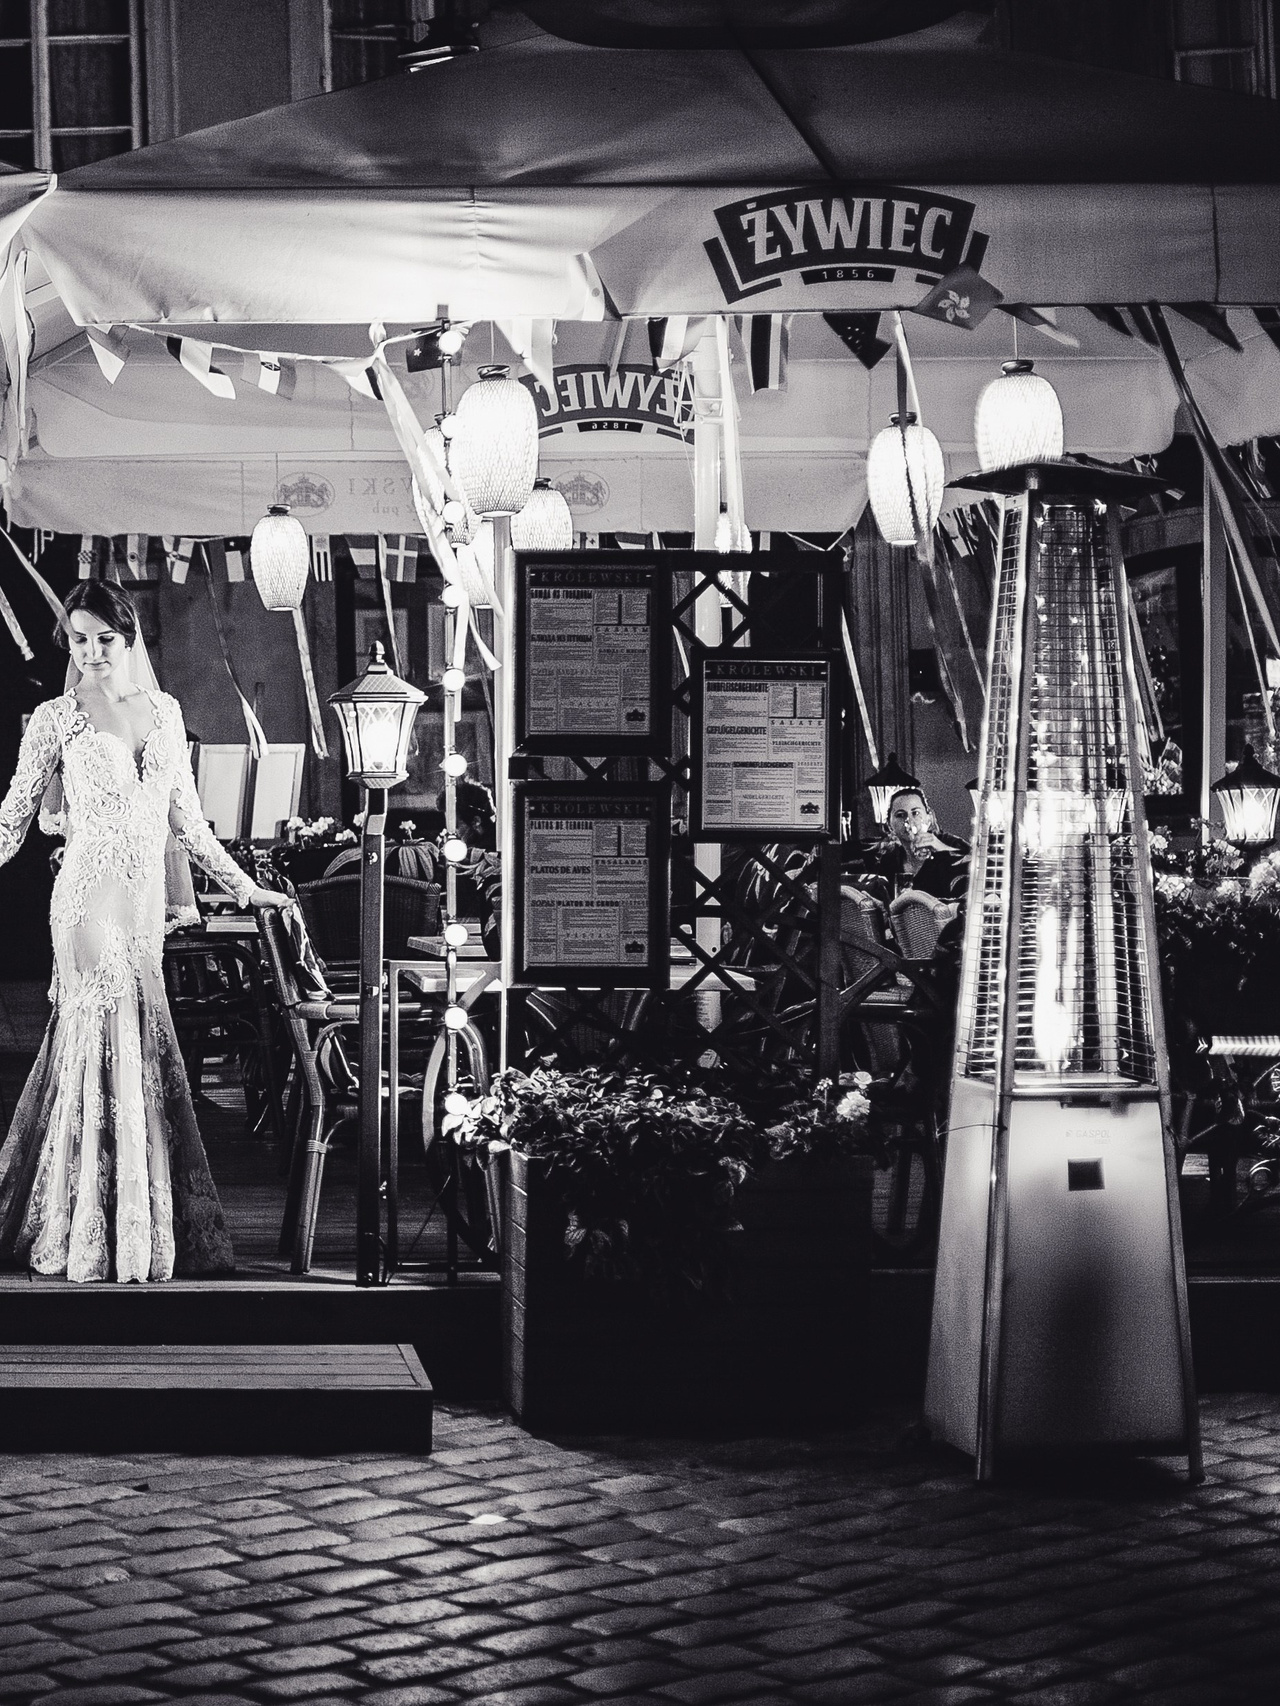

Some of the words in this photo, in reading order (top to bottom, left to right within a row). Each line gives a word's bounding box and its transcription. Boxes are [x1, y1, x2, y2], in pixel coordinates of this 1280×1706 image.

[740, 197, 953, 265] ŻYWIEC
[822, 269, 874, 278] 1856
[541, 570, 641, 582] KRÓLEWSKI
[717, 664, 815, 676] KRÓLEWSKI
[541, 802, 640, 814] KRÓLEWSKI
[531, 821, 553, 829] PLATOS
[531, 866, 559, 874] PLATOS
[560, 866, 571, 874] DE
[572, 866, 590, 874] AVES
[1076, 1129, 1111, 1138] GASPOL
